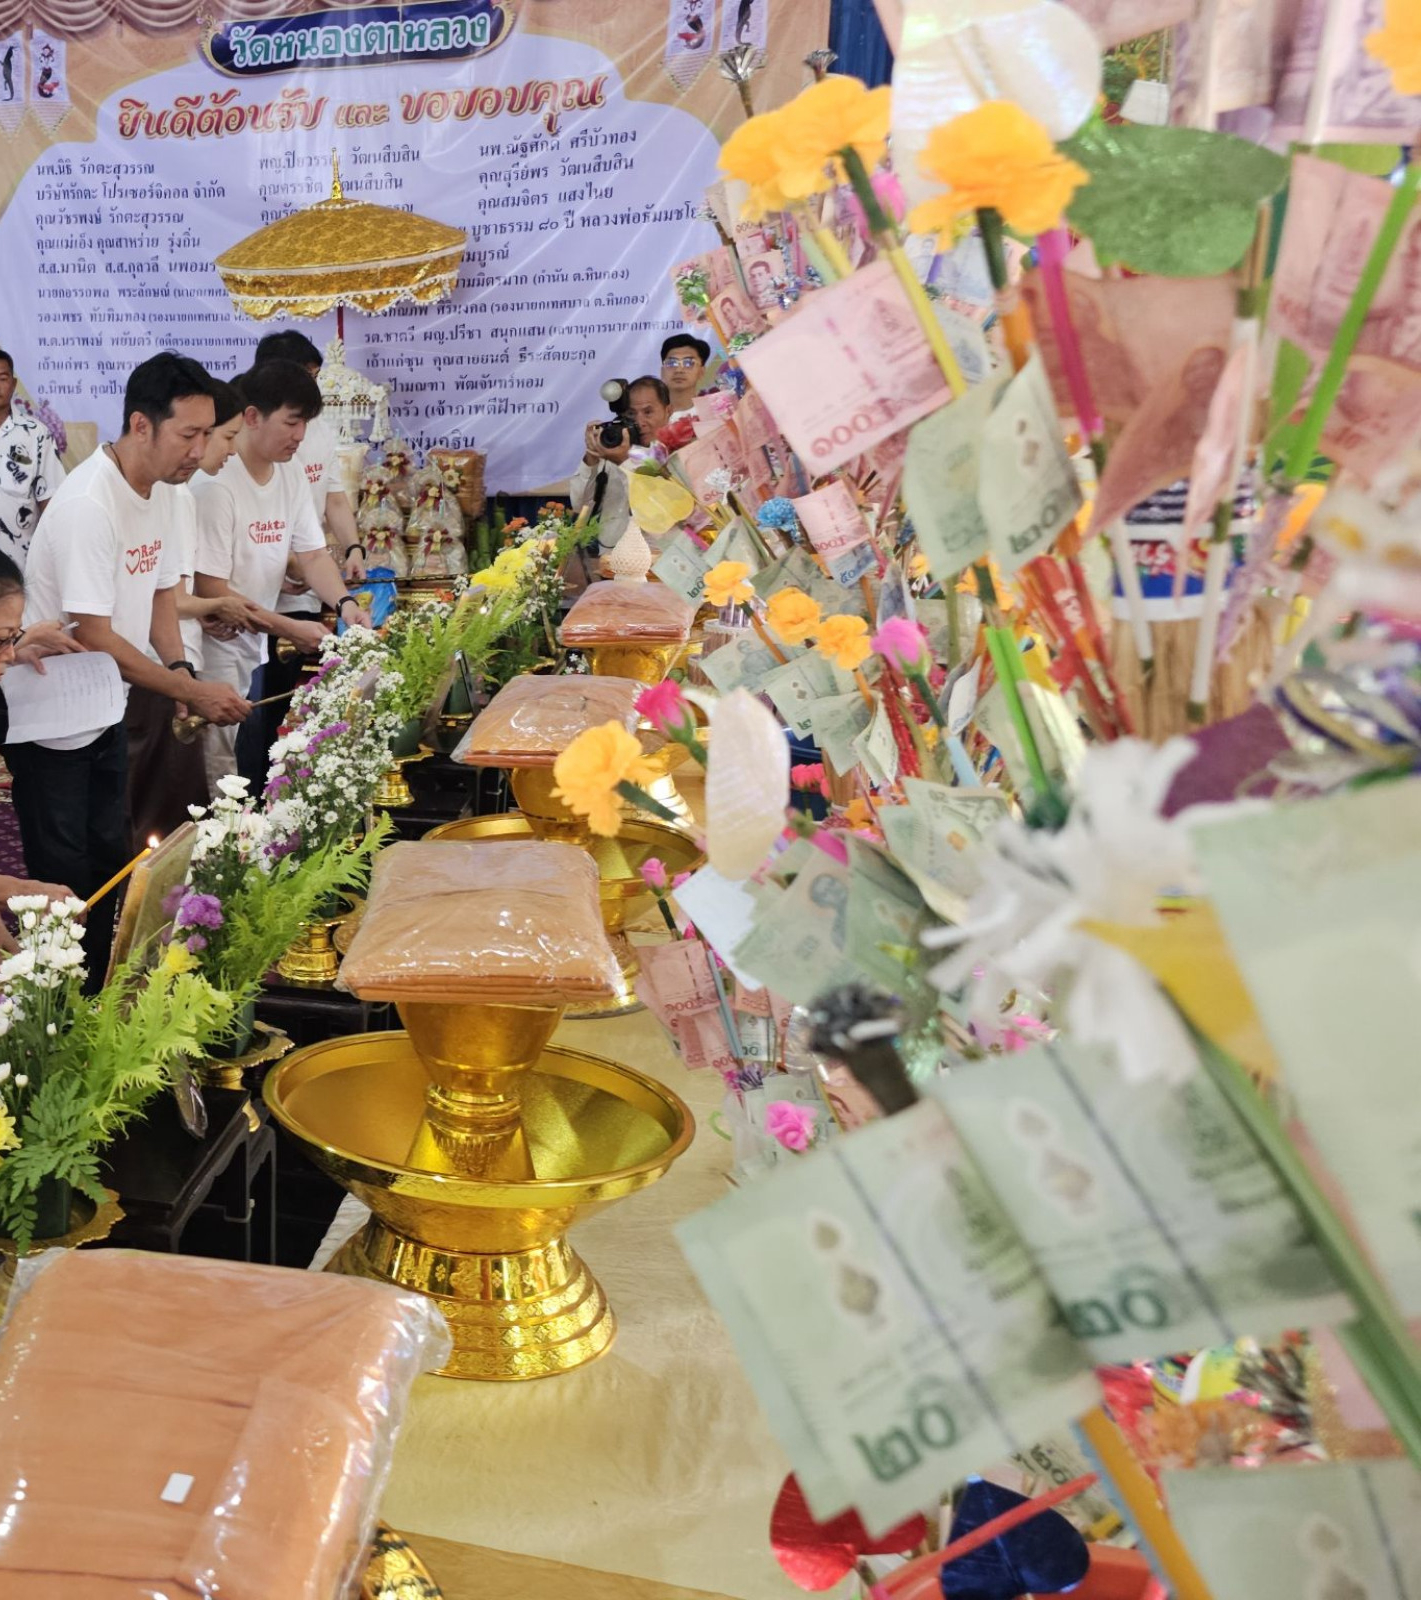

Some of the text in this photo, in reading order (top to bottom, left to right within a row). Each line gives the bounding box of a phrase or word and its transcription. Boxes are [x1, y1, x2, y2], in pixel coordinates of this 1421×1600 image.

[231, 12, 489, 70] วัดหนองตาหลวง
[118, 74, 609, 140] ยินดีต้อนรับ และ ขอขอบคุณ
[569, 127, 637, 150] ศรีบัวทอง
[80, 157, 155, 180] รักตะสุวรรณ
[560, 153, 635, 178] วัฒนสืบสิน
[193, 179, 226, 199] จำกัด
[109, 206, 184, 229] รักตะสุวรรณ
[472, 220, 534, 243] บูชาธรรม
[538, 218, 560, 231] ๘๐
[168, 261, 217, 274] นพอมร
